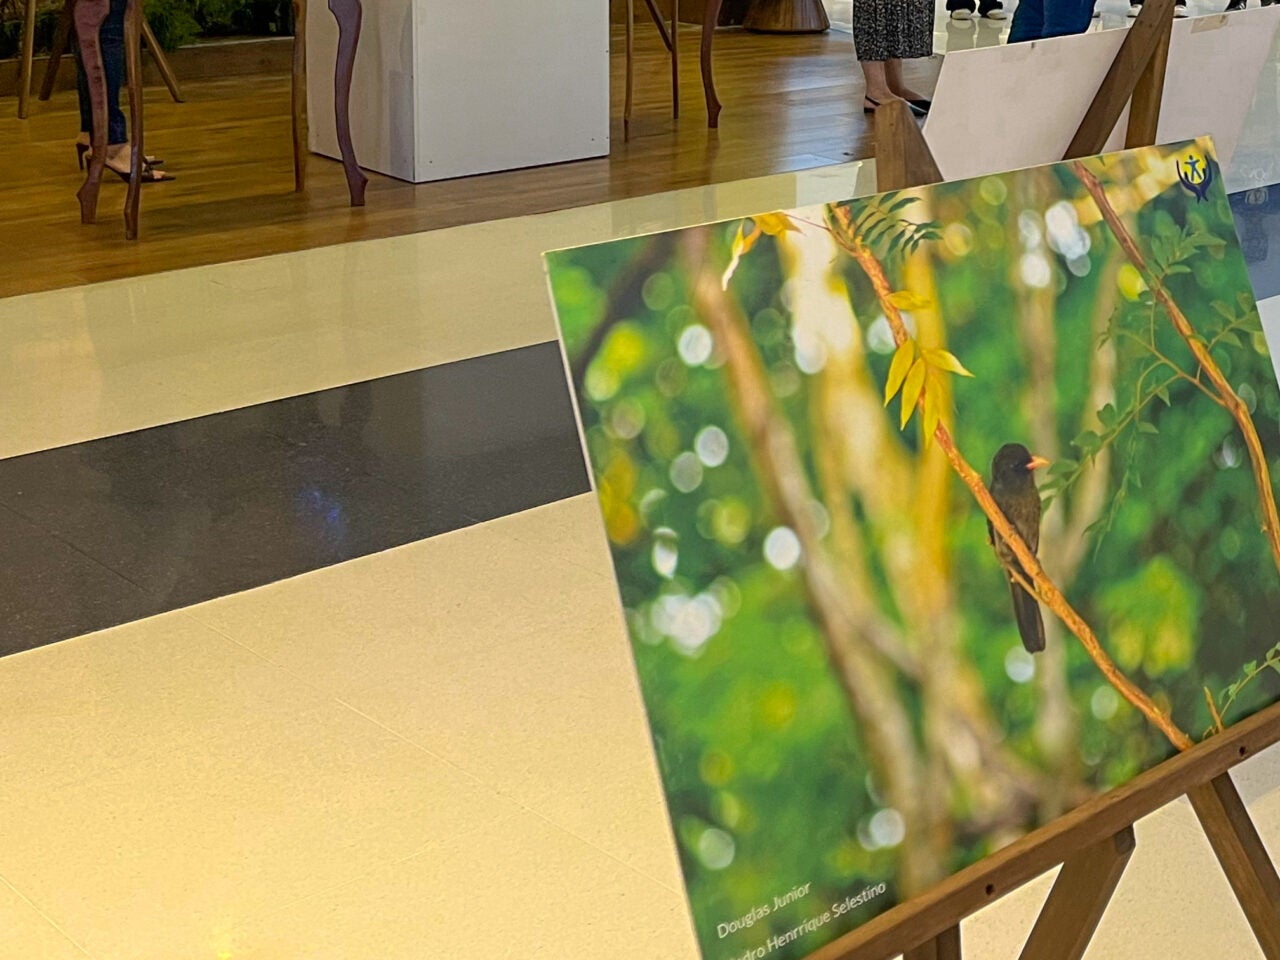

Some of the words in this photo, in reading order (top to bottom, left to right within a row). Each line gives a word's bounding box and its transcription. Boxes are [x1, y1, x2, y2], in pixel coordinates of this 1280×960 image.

[717, 903, 770, 939] Douglas
[773, 881, 811, 913] Junior
[766, 911, 831, 954] Henrrique
[832, 881, 887, 919] Selestino
